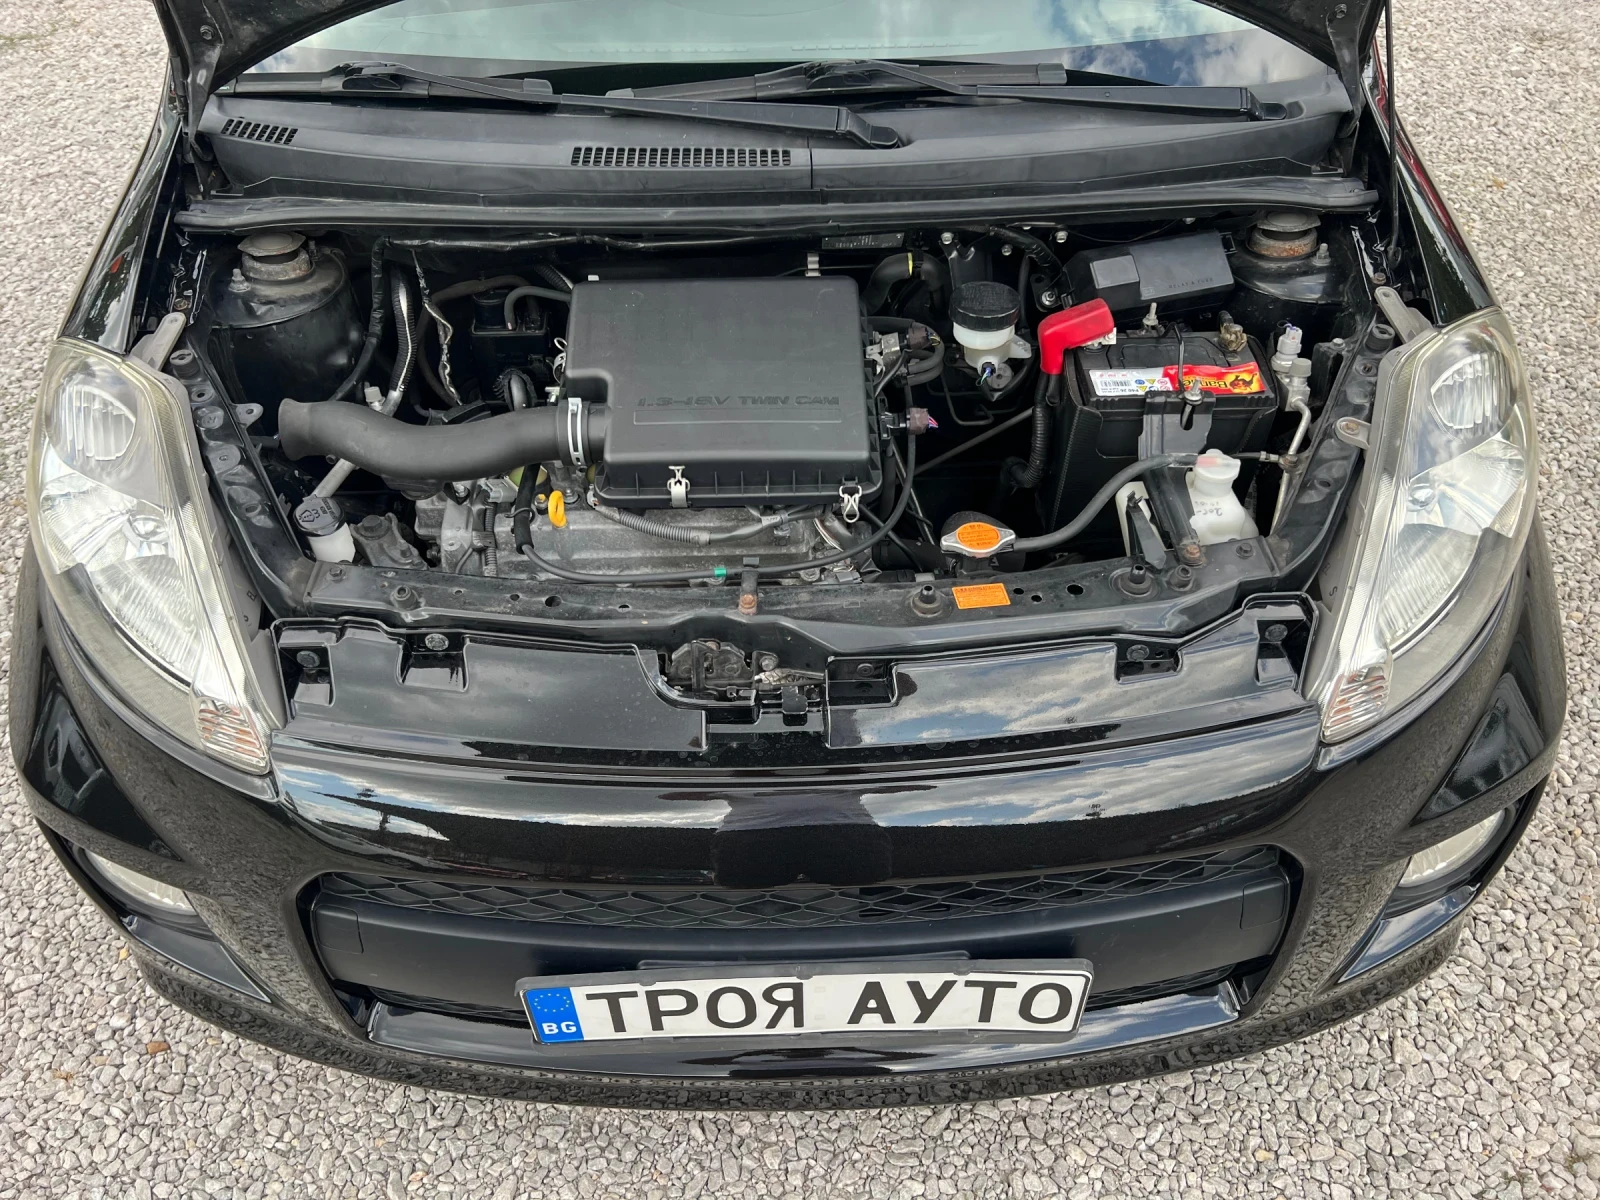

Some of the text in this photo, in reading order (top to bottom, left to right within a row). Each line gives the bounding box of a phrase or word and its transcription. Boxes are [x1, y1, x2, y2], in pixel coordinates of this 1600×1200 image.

[1178, 379, 1228, 389] Bane
[738, 396, 790, 405] TWIN
[795, 396, 840, 405] CAM
[586, 980, 1073, 1033] ТРОЯ АУТО
[542, 1022, 577, 1035] BG
